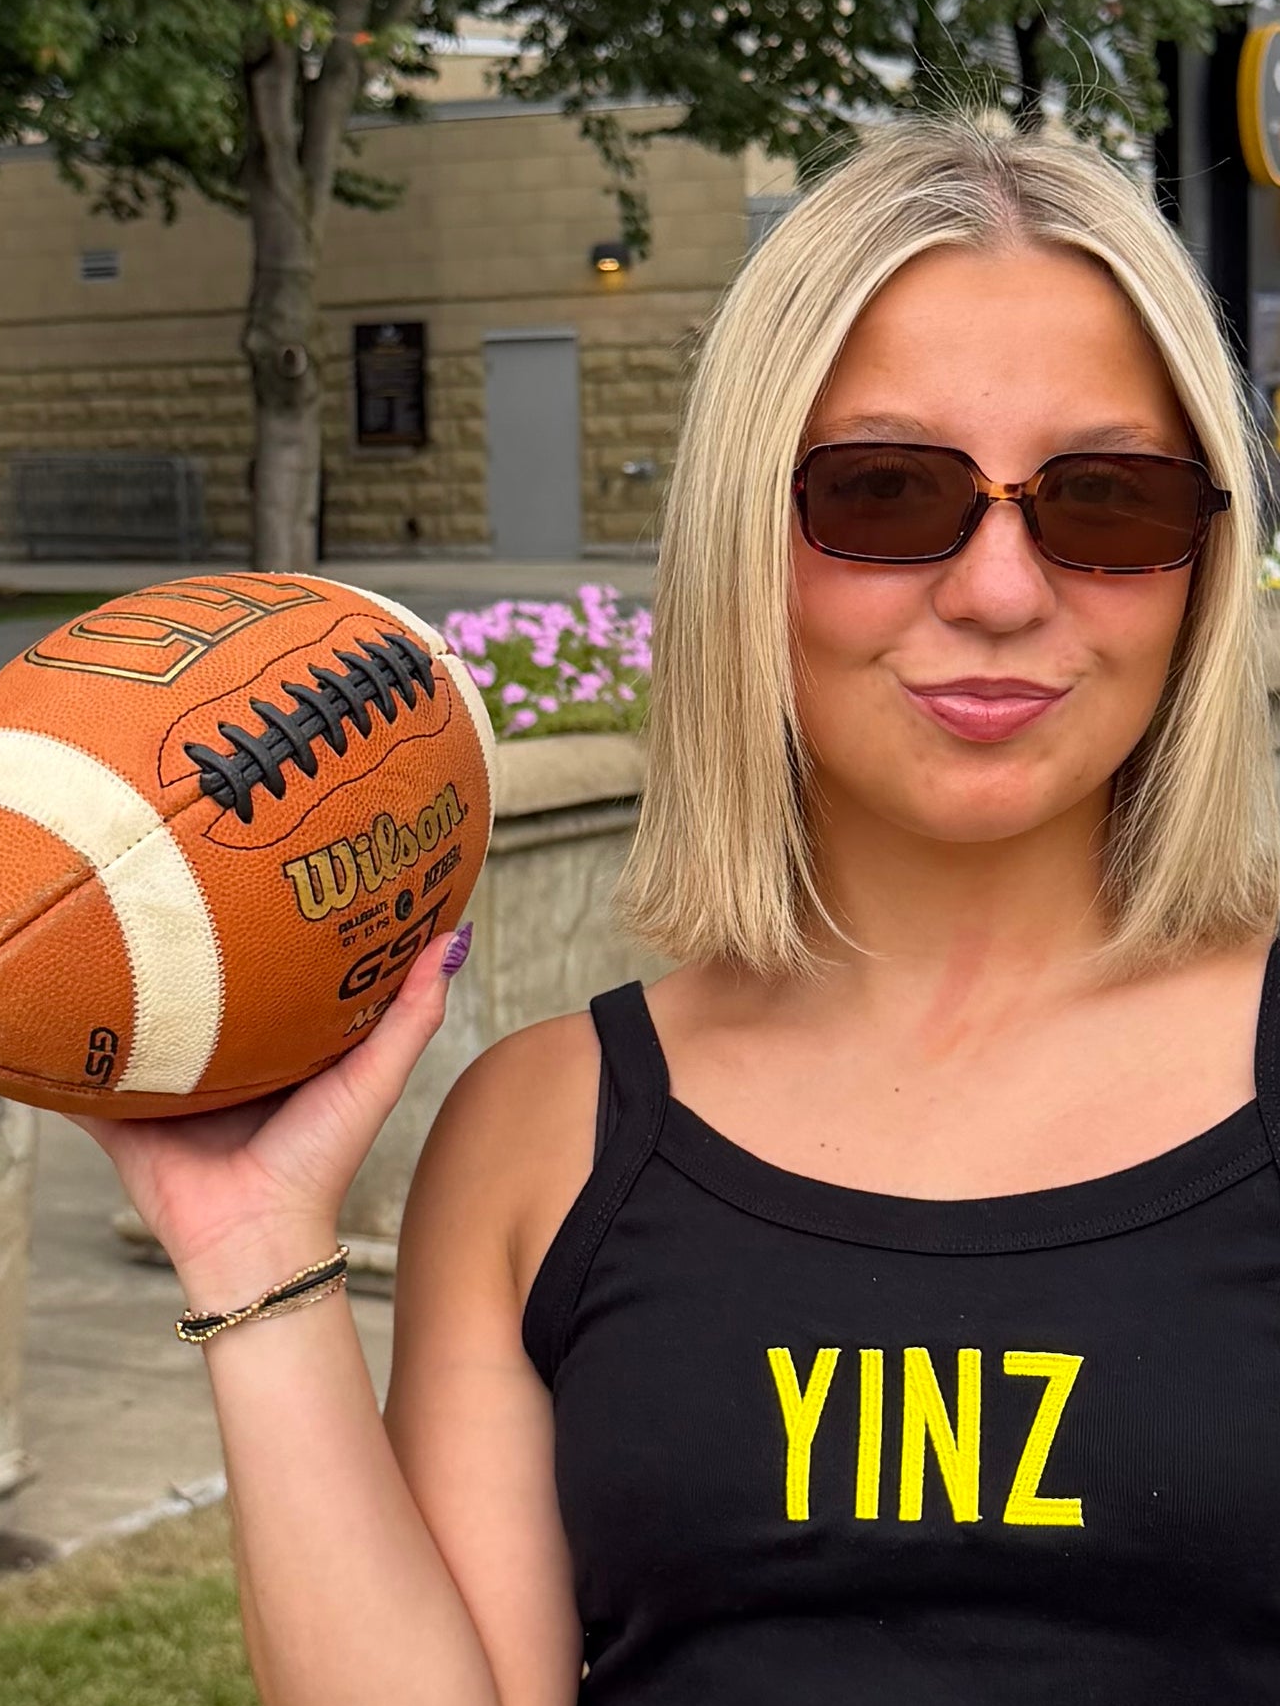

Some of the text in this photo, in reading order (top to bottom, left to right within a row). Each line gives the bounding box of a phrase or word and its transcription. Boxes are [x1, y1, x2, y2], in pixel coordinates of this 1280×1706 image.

[282, 782, 465, 922] Wilson
[338, 889, 451, 1001] GST
[767, 1346, 1085, 1527] YINZ
